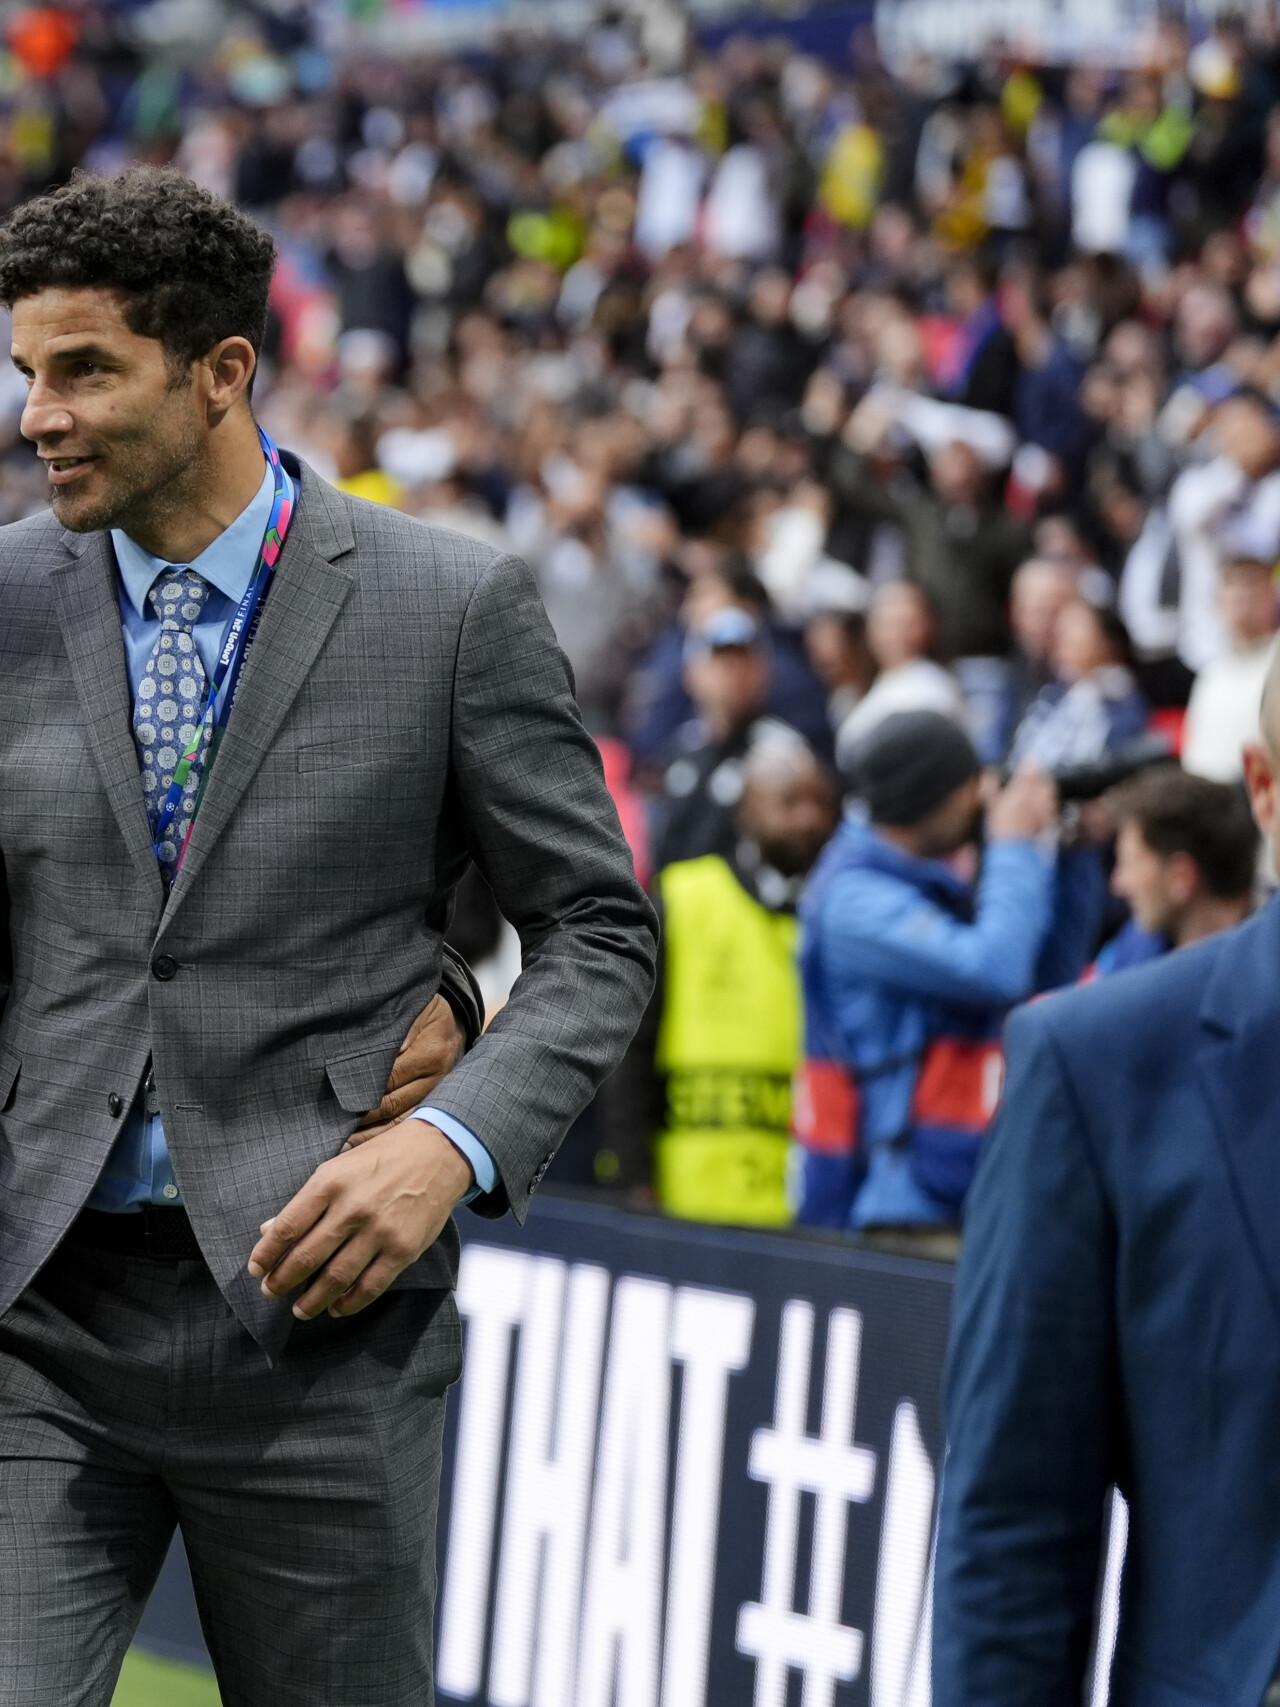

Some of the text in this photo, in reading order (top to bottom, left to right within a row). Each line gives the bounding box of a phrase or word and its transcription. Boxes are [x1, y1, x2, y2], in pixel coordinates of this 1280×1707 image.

[237, 587, 254, 617] FINAL
[232, 619, 243, 633] 24
[437, 1243, 756, 1707] THAT
